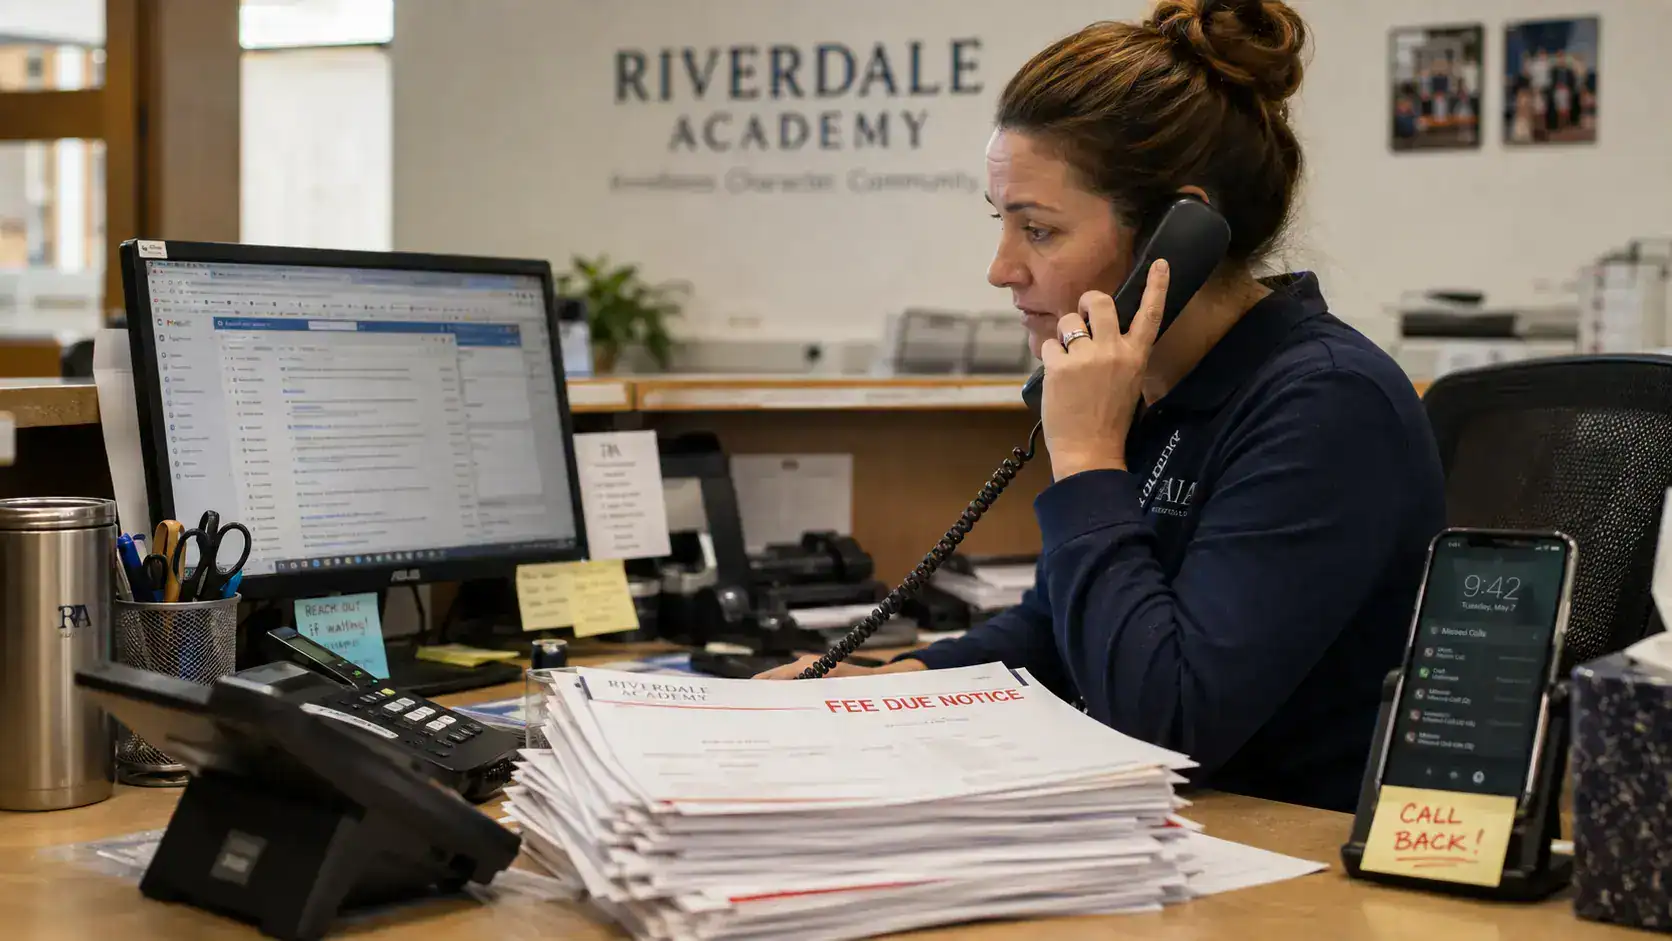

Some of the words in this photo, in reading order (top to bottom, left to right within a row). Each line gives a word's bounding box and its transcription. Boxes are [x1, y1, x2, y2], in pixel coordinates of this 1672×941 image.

[614, 37, 984, 104] RIVERDALE
[668, 109, 928, 152] ACADEMY
[1463, 574, 1521, 600] 9:42
[305, 603, 337, 617] REACH
[342, 601, 360, 613] OUT
[1461, 601, 1492, 612] Tuesday,
[1494, 603, 1509, 613] May
[1510, 604, 1517, 612] 7
[309, 622, 319, 637] if
[825, 699, 880, 713] FEE
[882, 696, 936, 711] DUE
[938, 688, 1025, 707] NOTICE
[1400, 802, 1462, 824] CALL
